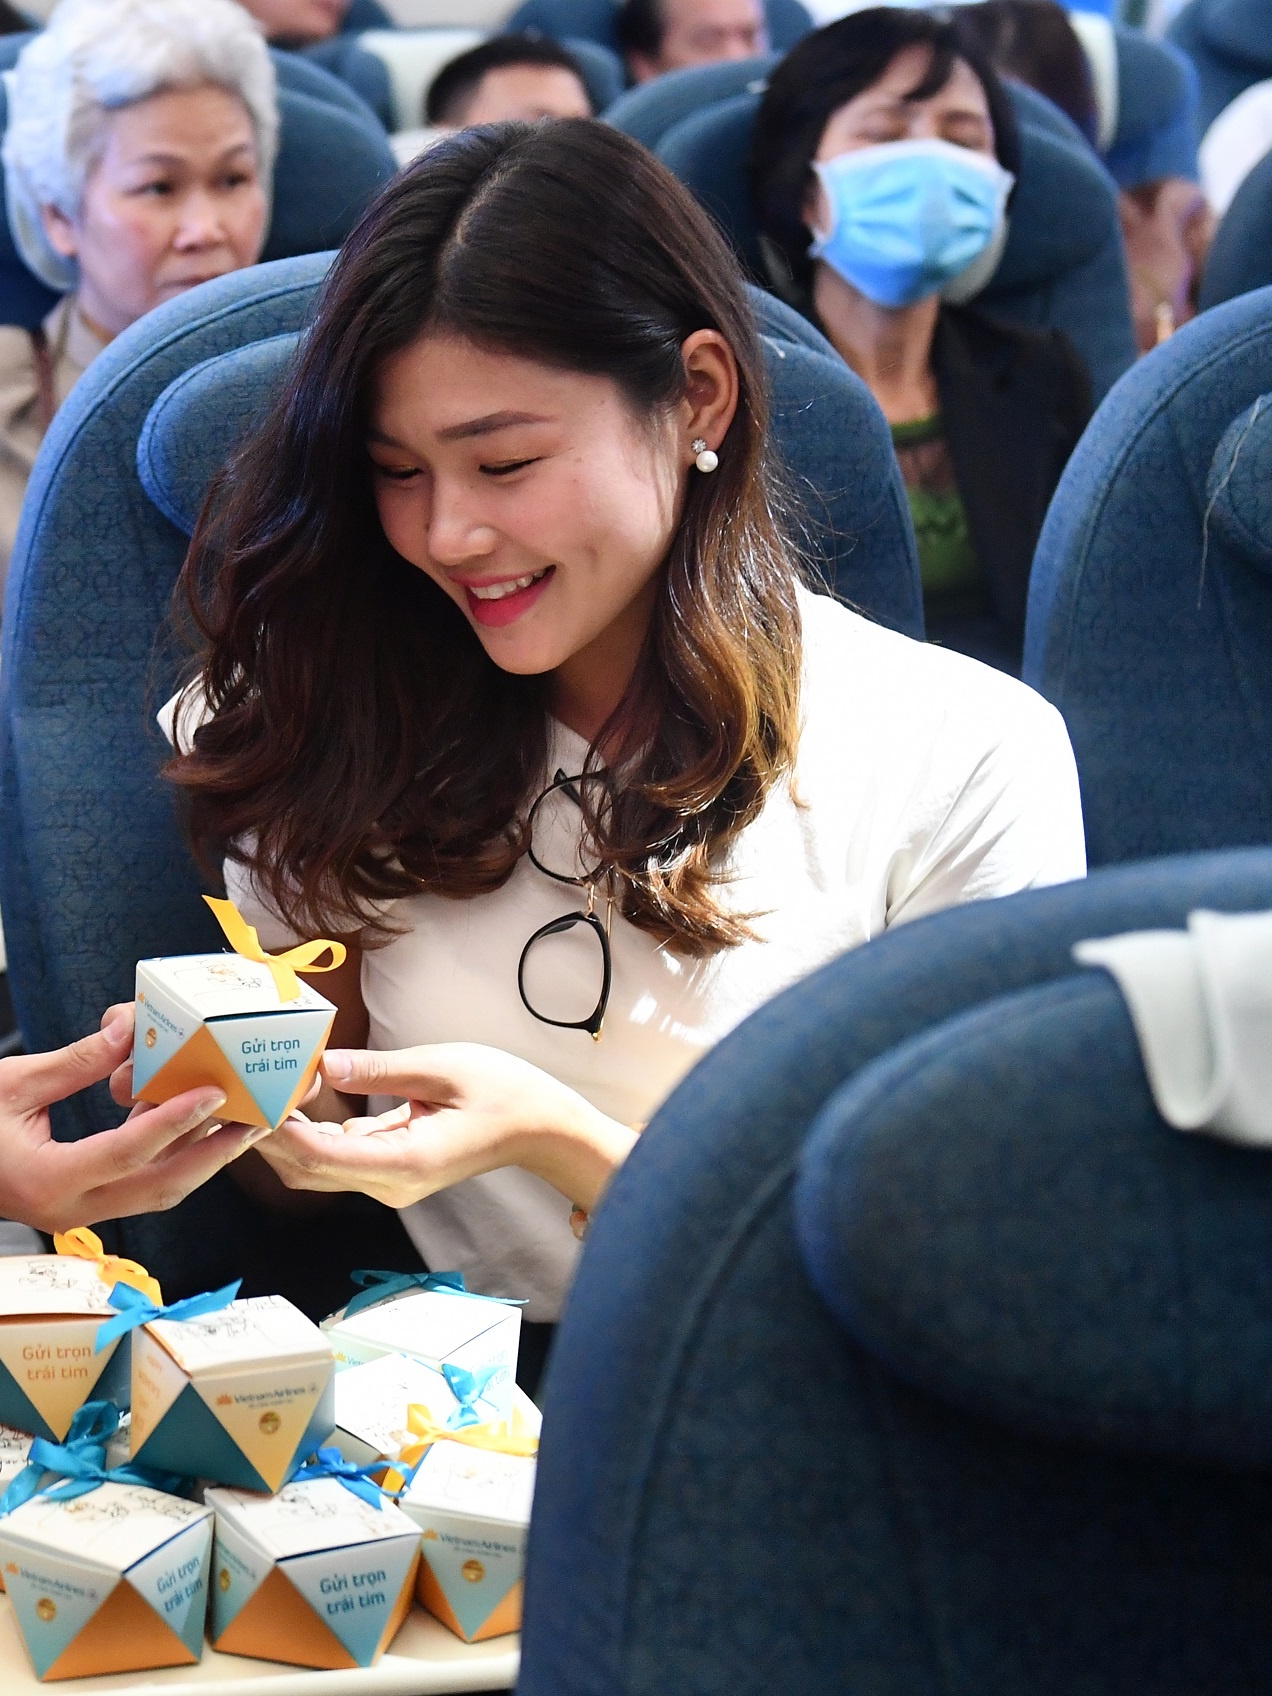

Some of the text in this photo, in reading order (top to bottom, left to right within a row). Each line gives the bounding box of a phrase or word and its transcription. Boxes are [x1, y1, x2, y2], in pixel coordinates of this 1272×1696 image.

[241, 1038, 300, 1054] Gửi trọn
[245, 1057, 298, 1074] trái tim
[22, 1344, 92, 1361] Gửi trọn
[27, 1366, 89, 1381] trái tim
[185, 1578, 203, 1598] tim
[319, 1569, 386, 1595] Gửi trọn
[327, 1591, 386, 1615] trái tim
